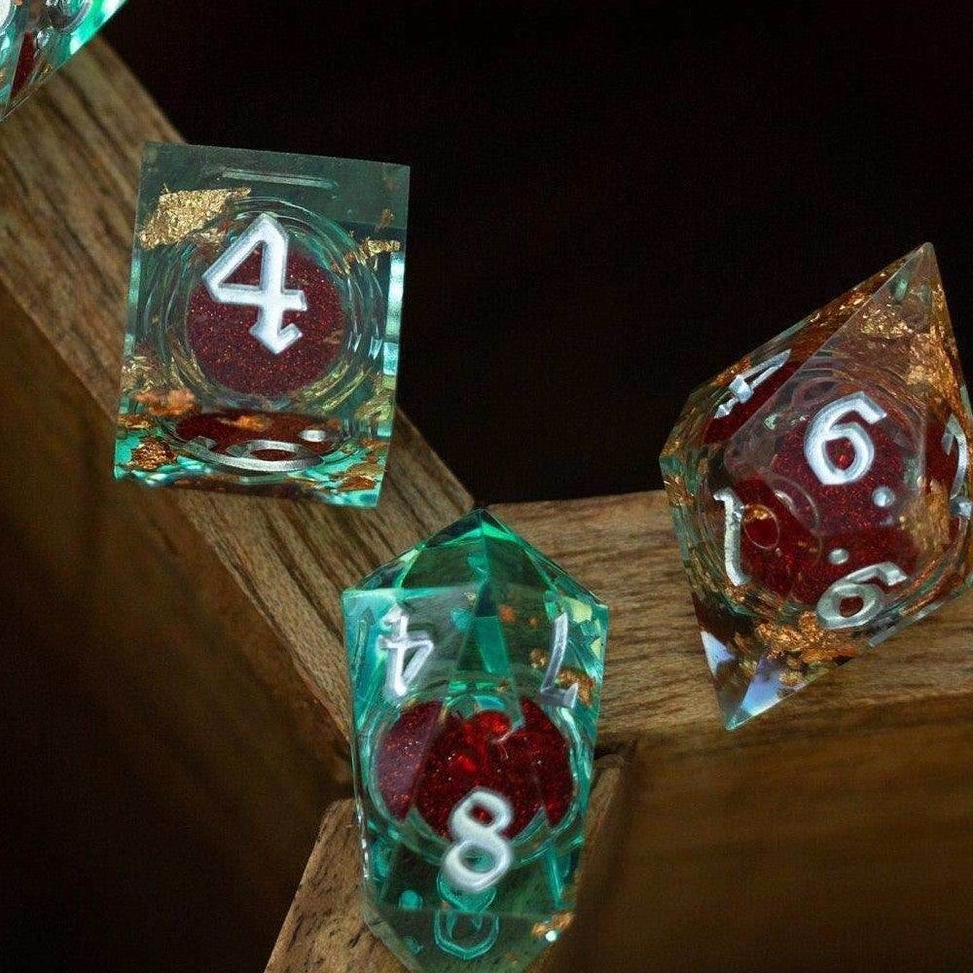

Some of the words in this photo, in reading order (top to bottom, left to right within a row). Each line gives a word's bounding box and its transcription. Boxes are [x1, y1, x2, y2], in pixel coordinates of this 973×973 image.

[201, 212, 309, 356] 4
[378, 602, 435, 700] 4
[438, 786, 514, 893] 8
